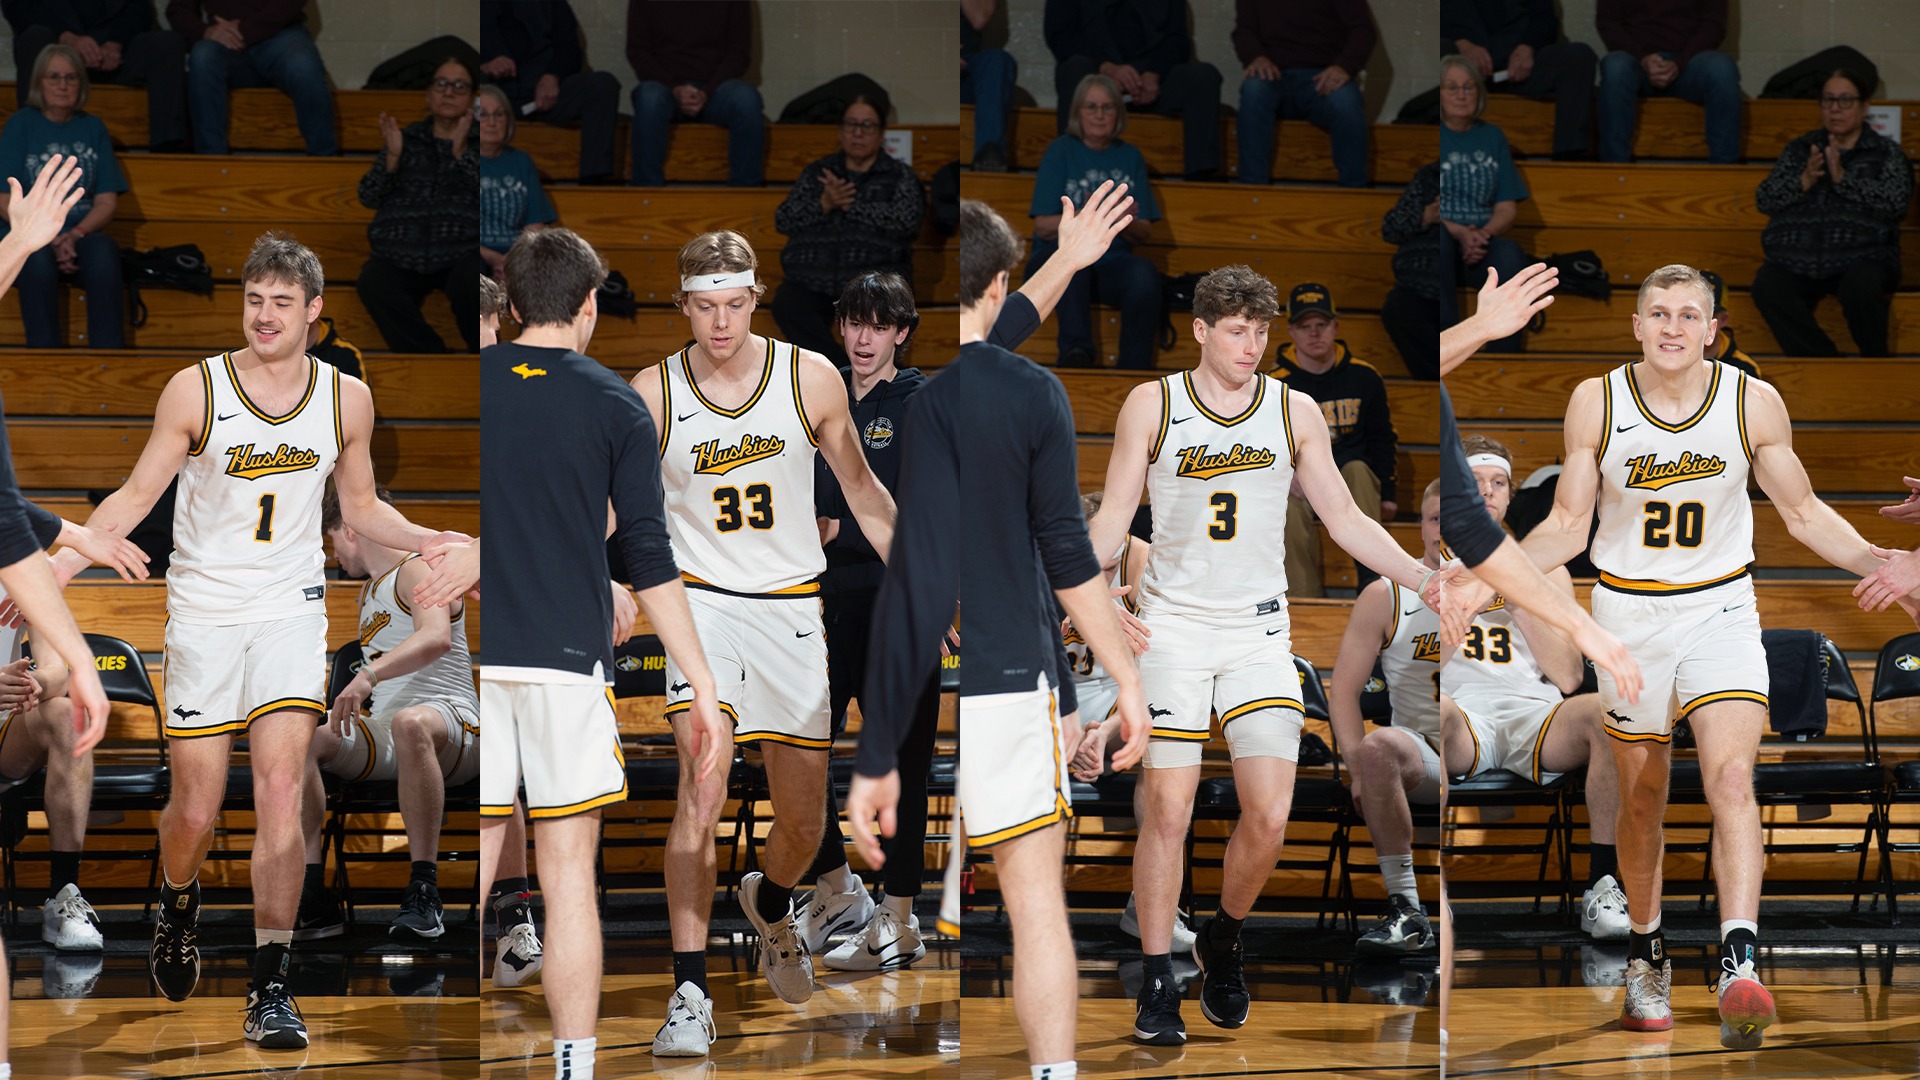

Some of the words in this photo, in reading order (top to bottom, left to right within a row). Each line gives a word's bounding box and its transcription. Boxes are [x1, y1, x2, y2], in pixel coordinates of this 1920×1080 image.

[223, 443, 320, 481] Huskies
[690, 433, 786, 477] Huskies
[1175, 443, 1276, 481] Huskies
[1624, 450, 1726, 492] Huskies
[253, 491, 277, 544] 1
[711, 481, 775, 535] 33
[1207, 490, 1239, 543] 3
[1641, 499, 1707, 550] 20
[94, 655, 128, 671] KIES
[642, 655, 667, 671] HU
[1461, 623, 1513, 665] 33
